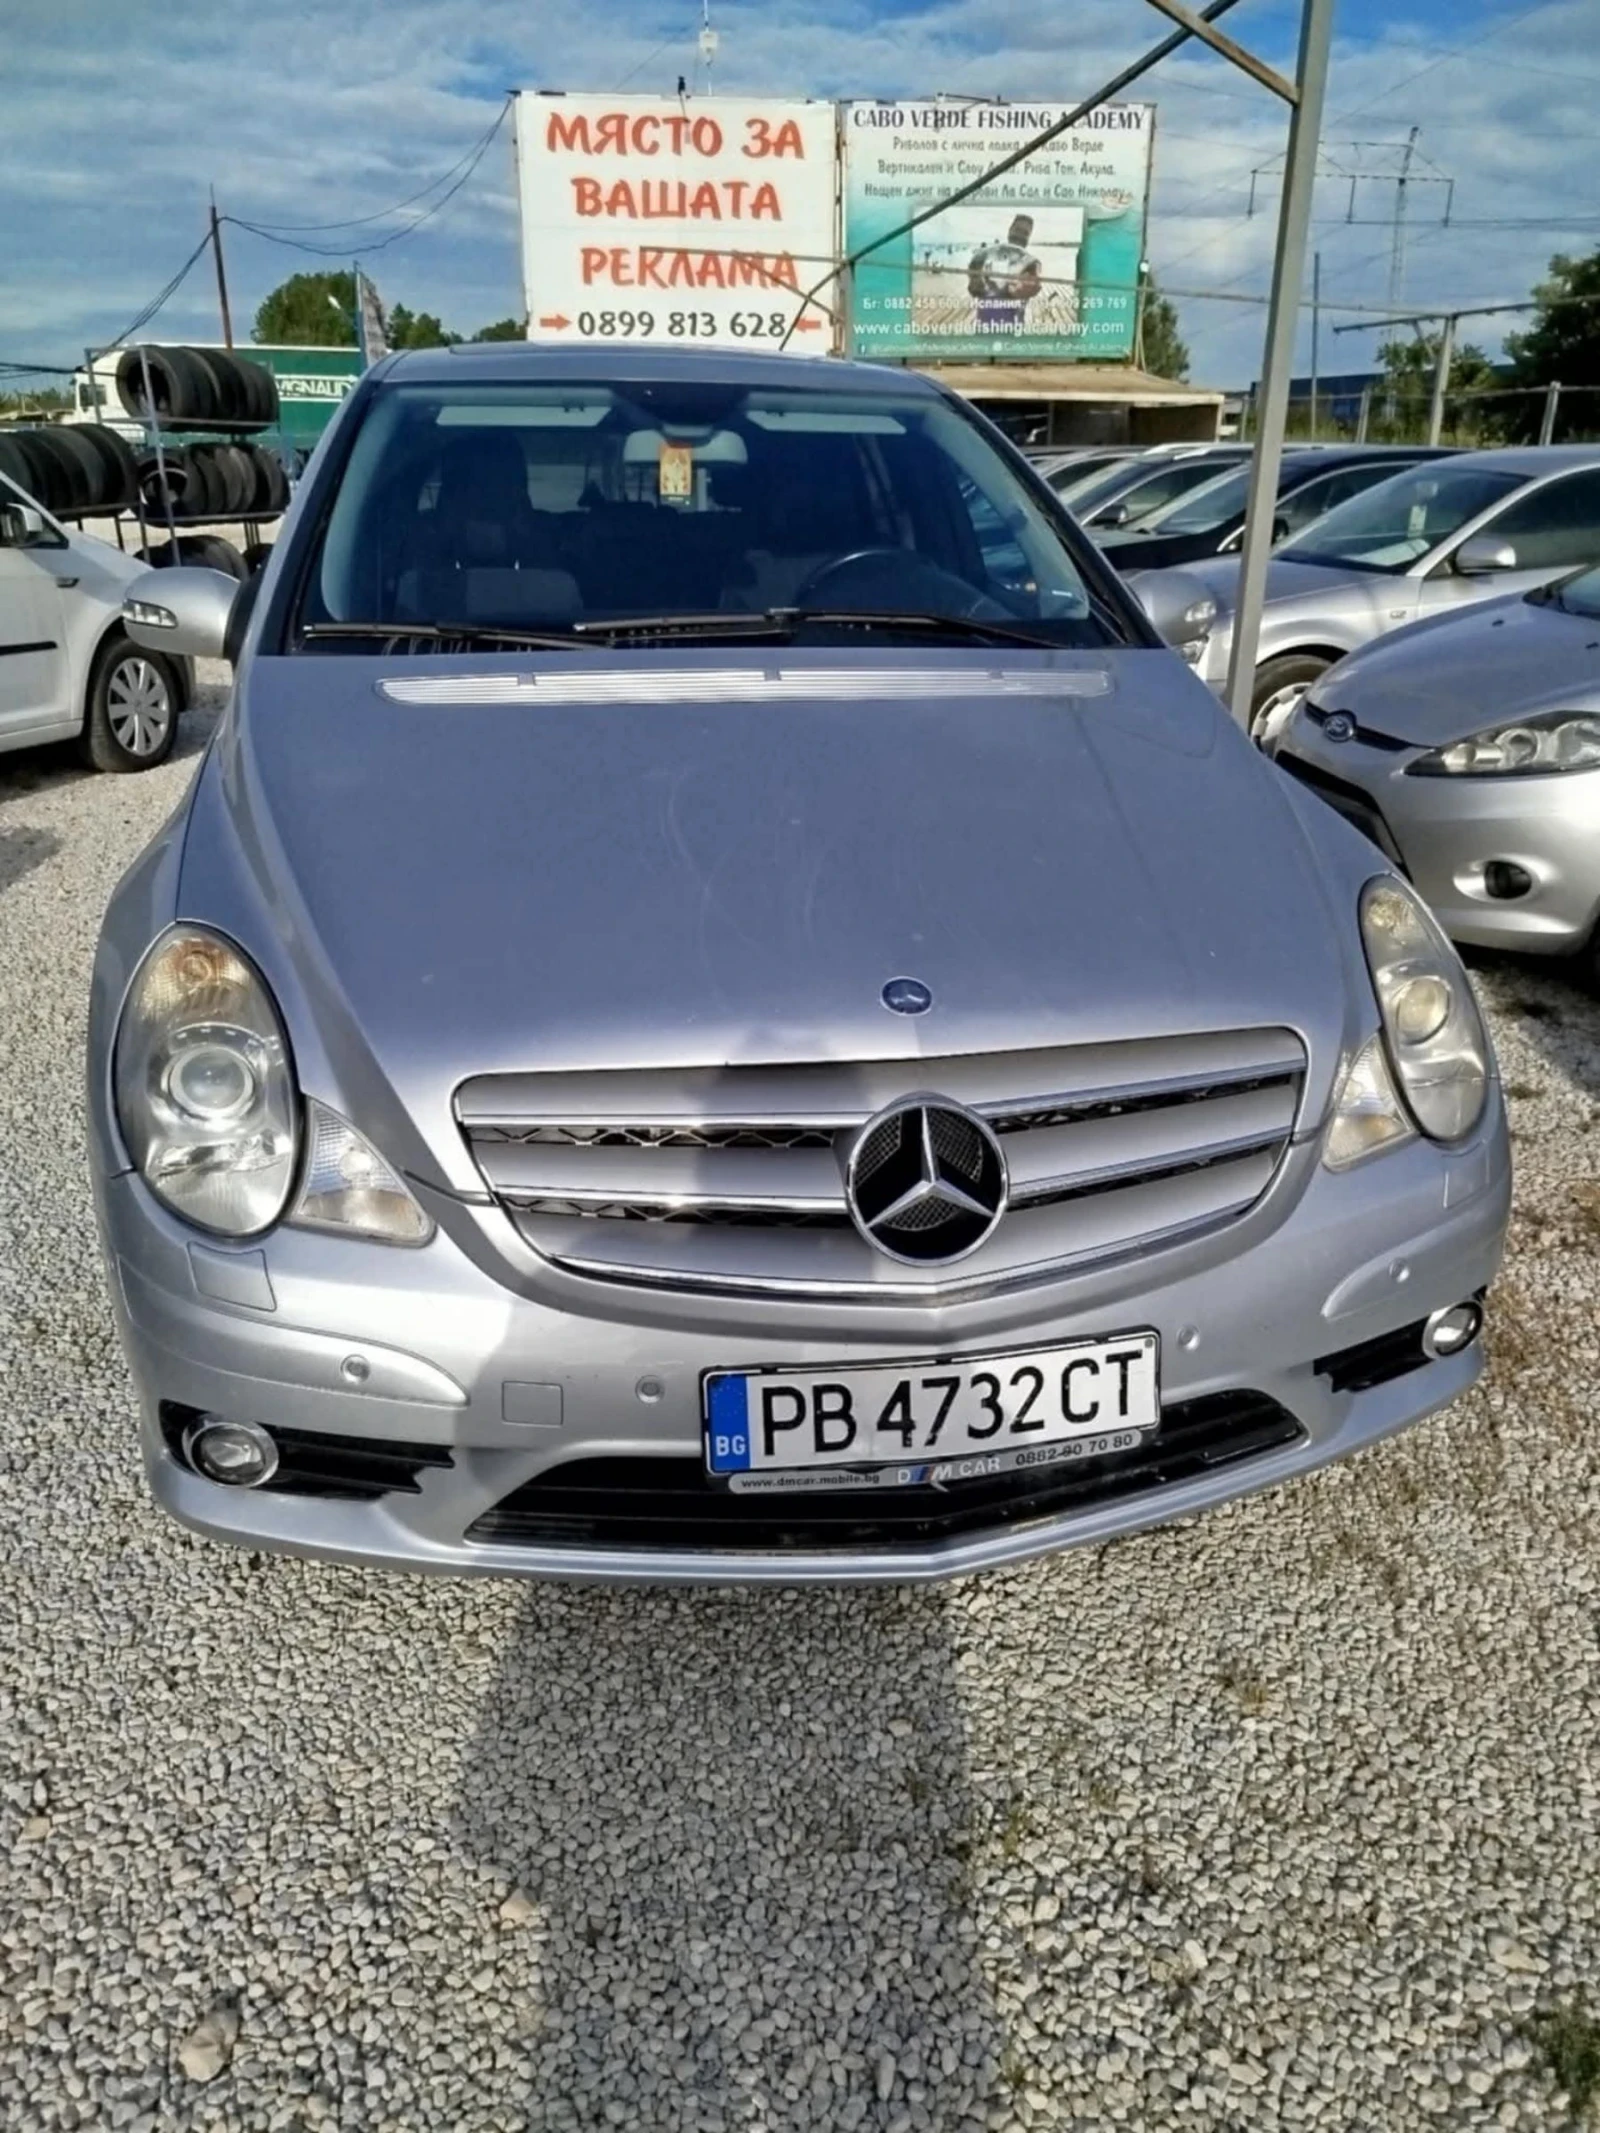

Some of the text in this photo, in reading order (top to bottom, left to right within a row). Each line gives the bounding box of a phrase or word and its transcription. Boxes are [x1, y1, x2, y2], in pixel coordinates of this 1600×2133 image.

[546, 112, 804, 159] МЯСТО ЗА
[854, 109, 904, 128] CABO
[911, 110, 971, 129] VERDE
[978, 110, 1051, 129] FISHING
[571, 177, 782, 221] ВАШАТА
[581, 247, 798, 289] РЕКЛАМА
[578, 311, 785, 338] 0899 813 628
[762, 1350, 1143, 1456] PB 4732 CT
[715, 1435, 746, 1457] BG
[741, 1473, 880, 1487] www.dmcar.mobile.bg
[960, 1457, 1000, 1475] CAR
[1016, 1450, 1057, 1466] 0882
[1089, 1439, 1108, 1453] 70
[1113, 1433, 1133, 1448] 80
